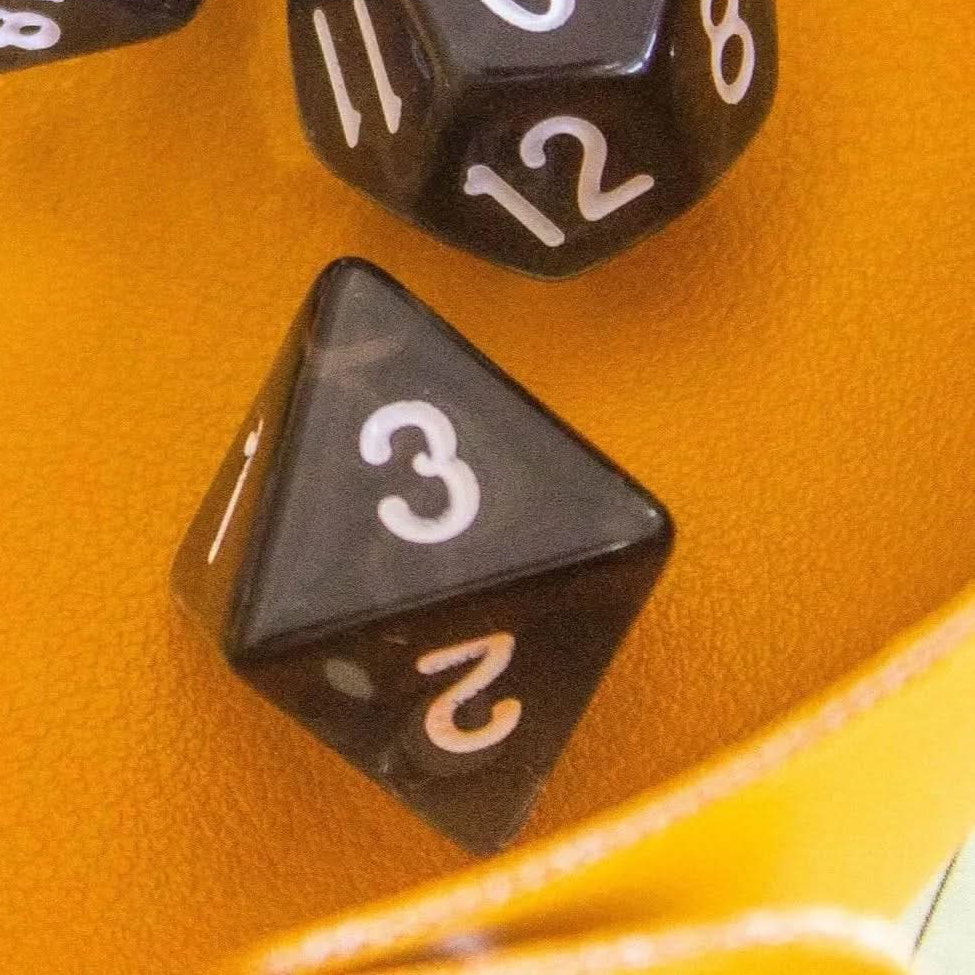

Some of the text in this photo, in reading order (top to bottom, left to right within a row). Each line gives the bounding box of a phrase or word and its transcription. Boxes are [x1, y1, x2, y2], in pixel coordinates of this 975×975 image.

[464, 116, 654, 247] 12
[359, 399, 481, 543] 3
[415, 631, 521, 753] 2
